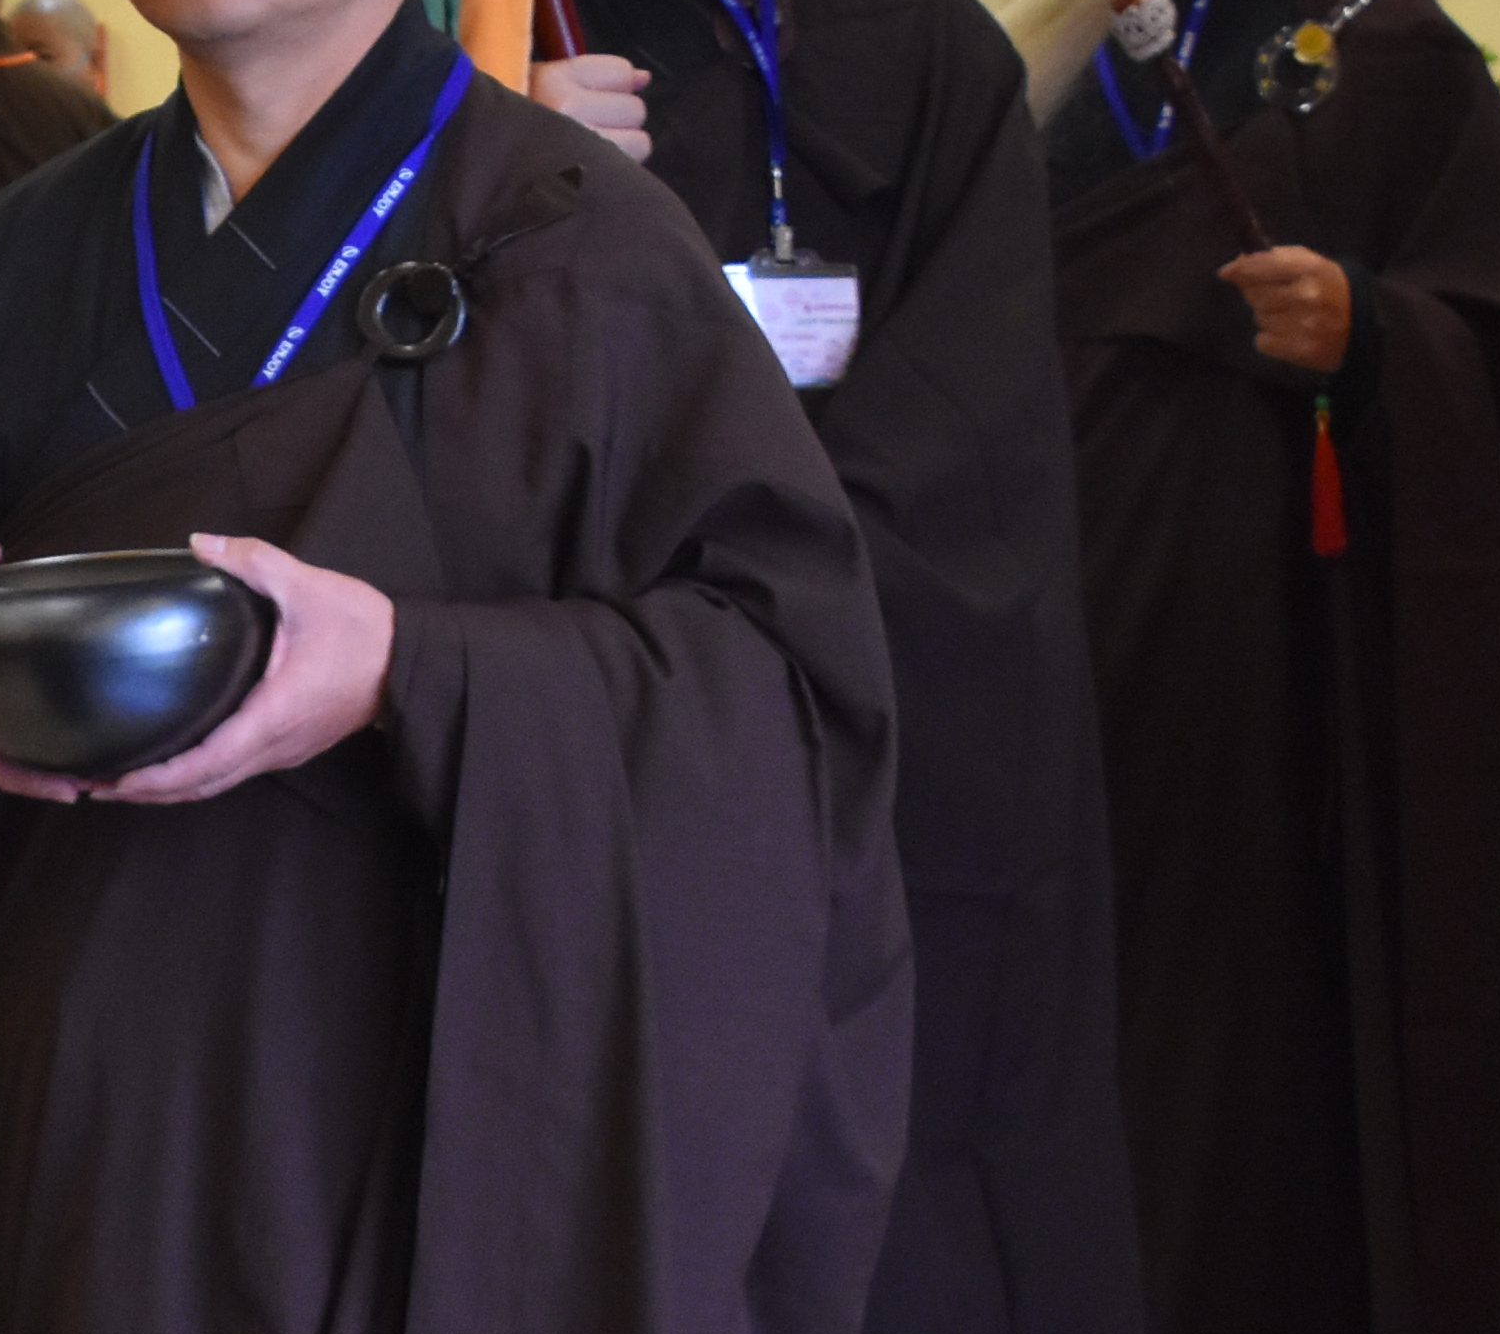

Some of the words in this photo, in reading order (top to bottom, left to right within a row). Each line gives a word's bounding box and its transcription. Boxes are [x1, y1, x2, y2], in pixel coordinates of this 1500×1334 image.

[372, 179, 404, 217] ENJOY
[317, 258, 349, 297] ENJOY
[262, 340, 294, 379] ENJOY
